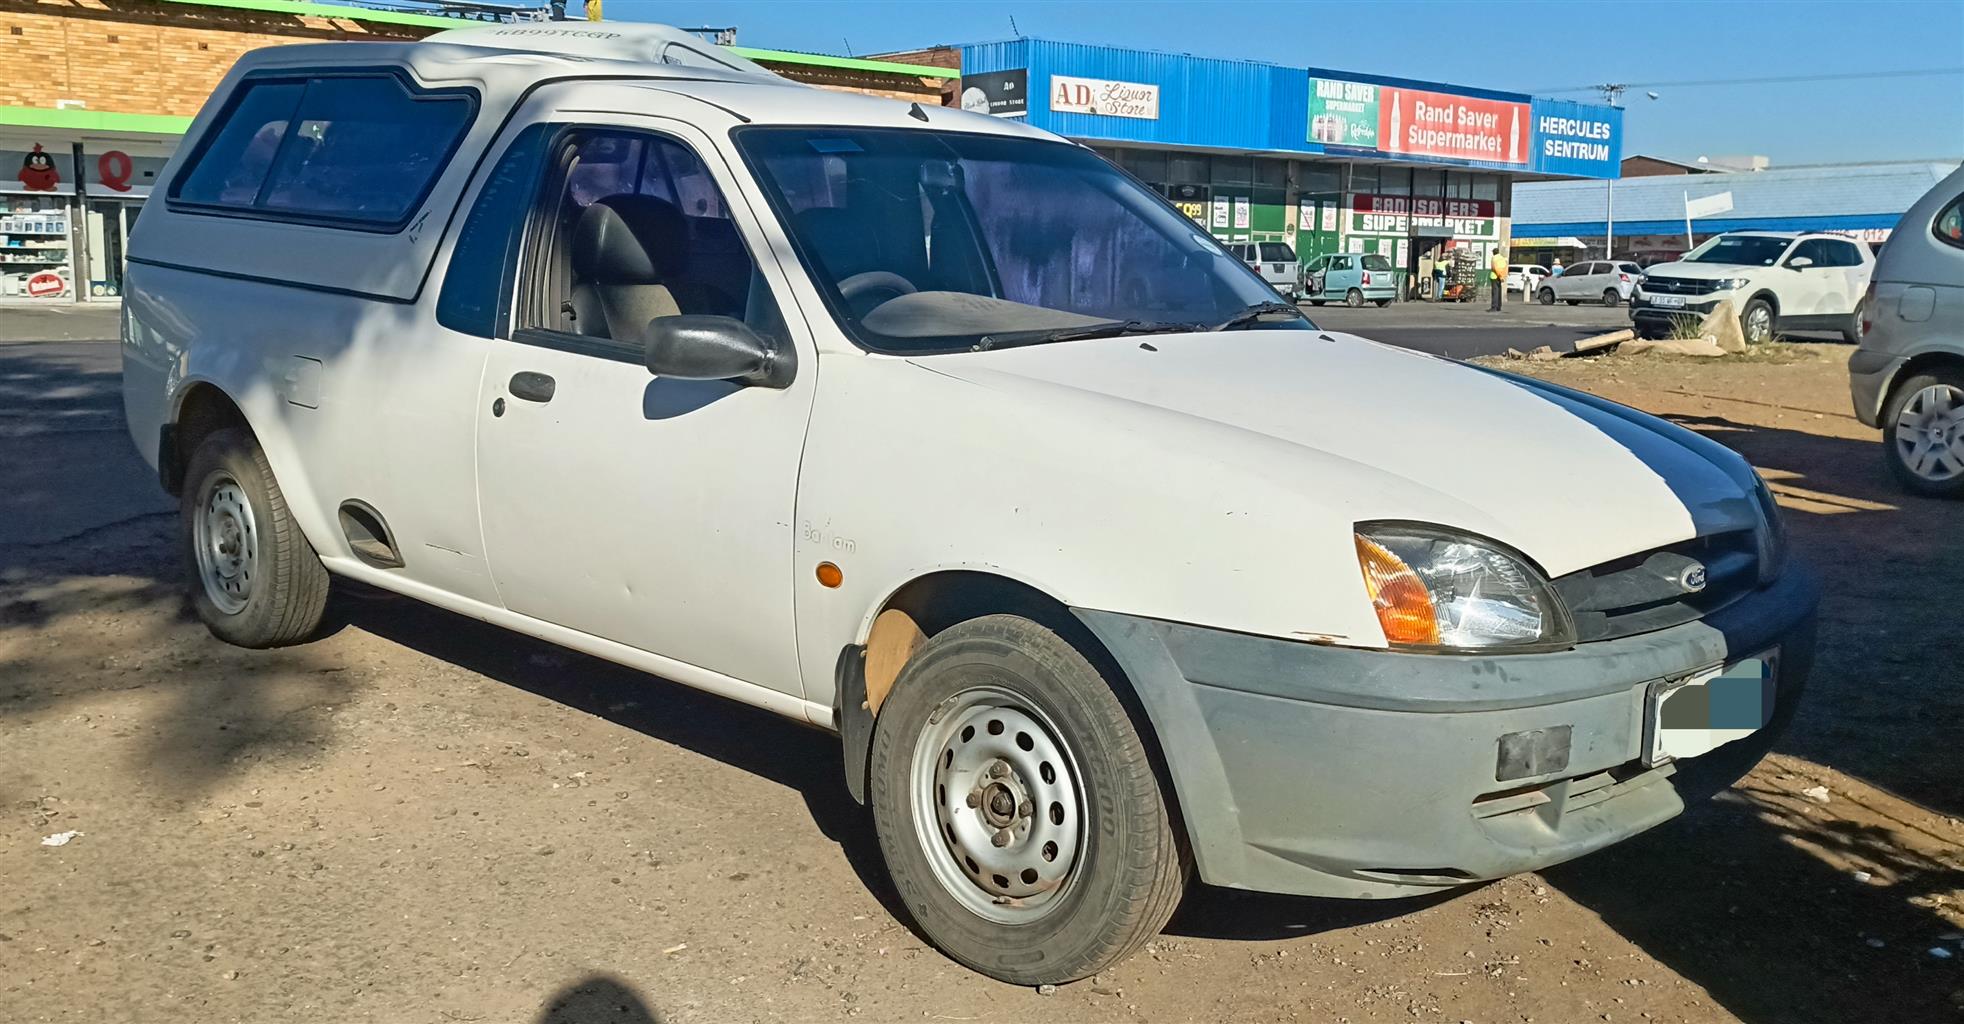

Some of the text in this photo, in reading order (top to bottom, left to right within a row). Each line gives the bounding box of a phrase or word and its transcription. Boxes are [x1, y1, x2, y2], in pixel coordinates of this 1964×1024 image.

[1101, 83, 1152, 102] Liquor
[1316, 80, 1374, 103] RAND SAVER
[1105, 101, 1145, 115] Store
[1415, 101, 1498, 129] Rand Saver
[1408, 124, 1502, 152] Supermarket
[1540, 115, 1611, 139] HERCULES
[1545, 139, 1609, 161] SENTRUM
[98, 150, 133, 192] Q
[801, 519, 856, 553] Baam
